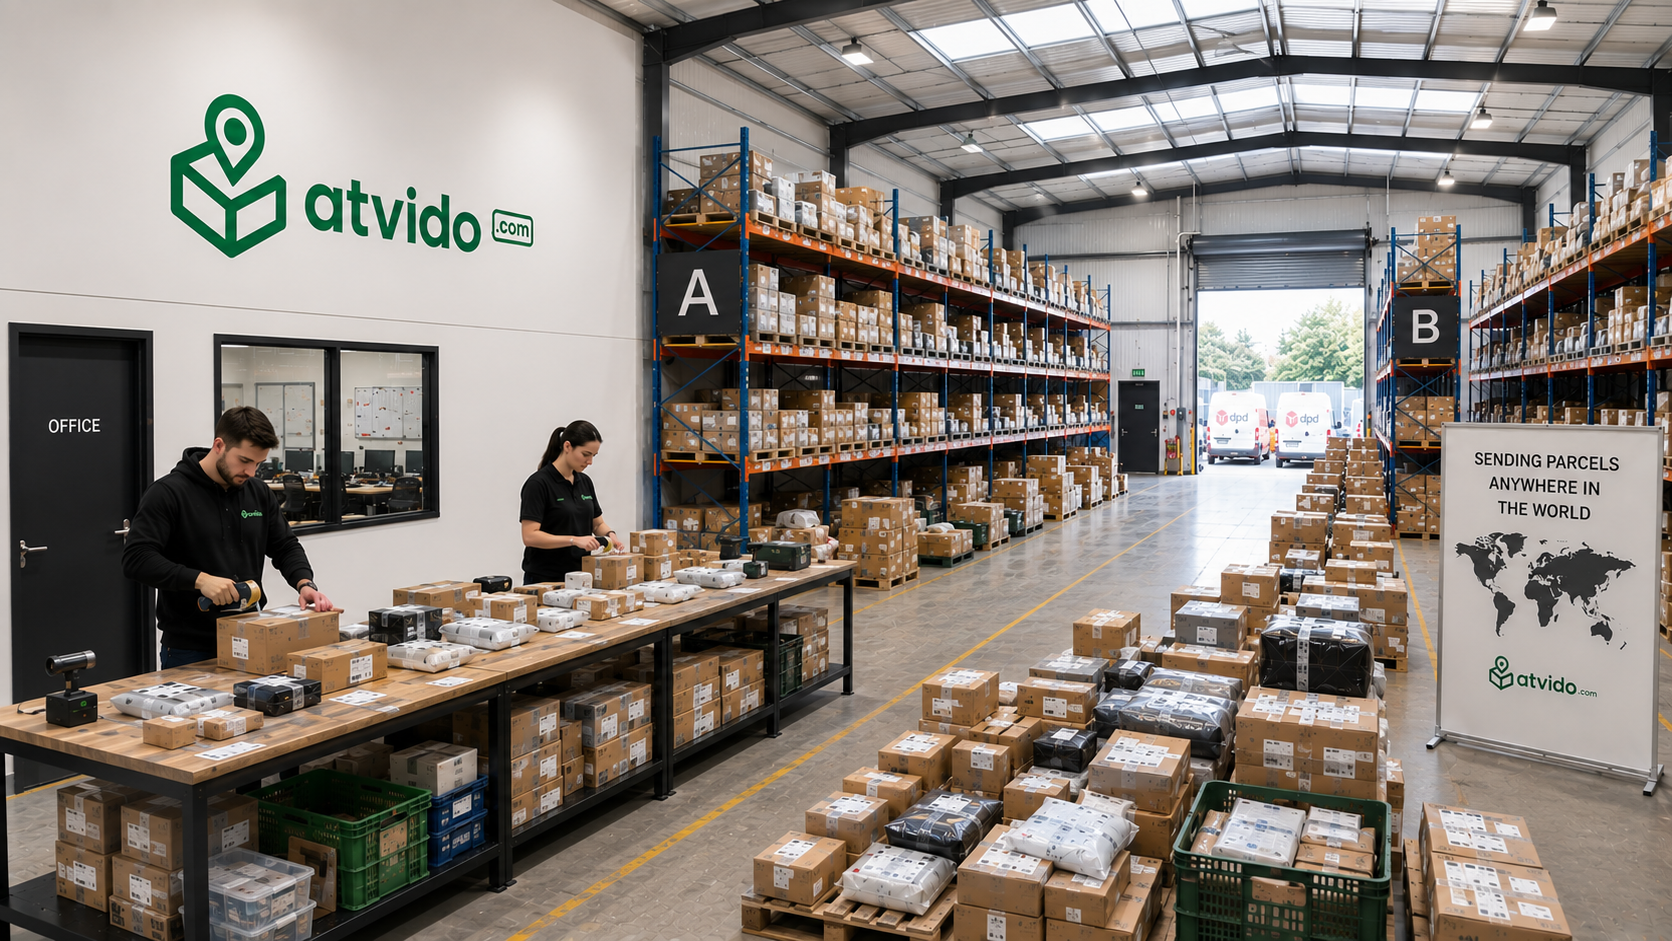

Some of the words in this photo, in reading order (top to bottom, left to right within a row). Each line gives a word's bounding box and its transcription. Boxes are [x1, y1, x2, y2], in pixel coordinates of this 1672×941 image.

[304, 179, 482, 253] atvido
[495, 220, 529, 238] .com
[677, 268, 720, 317] A
[1411, 308, 1441, 345] B
[48, 418, 101, 434] OFFICE
[1229, 412, 1249, 424] dpd
[1299, 413, 1319, 426] dpd
[1473, 451, 1543, 469] SENDING
[1546, 454, 1620, 472] PARCELS
[1488, 475, 1578, 495] ANYWHERE
[1583, 480, 1601, 496] IN
[1497, 500, 1528, 517] THE
[1532, 502, 1592, 521] WORLD
